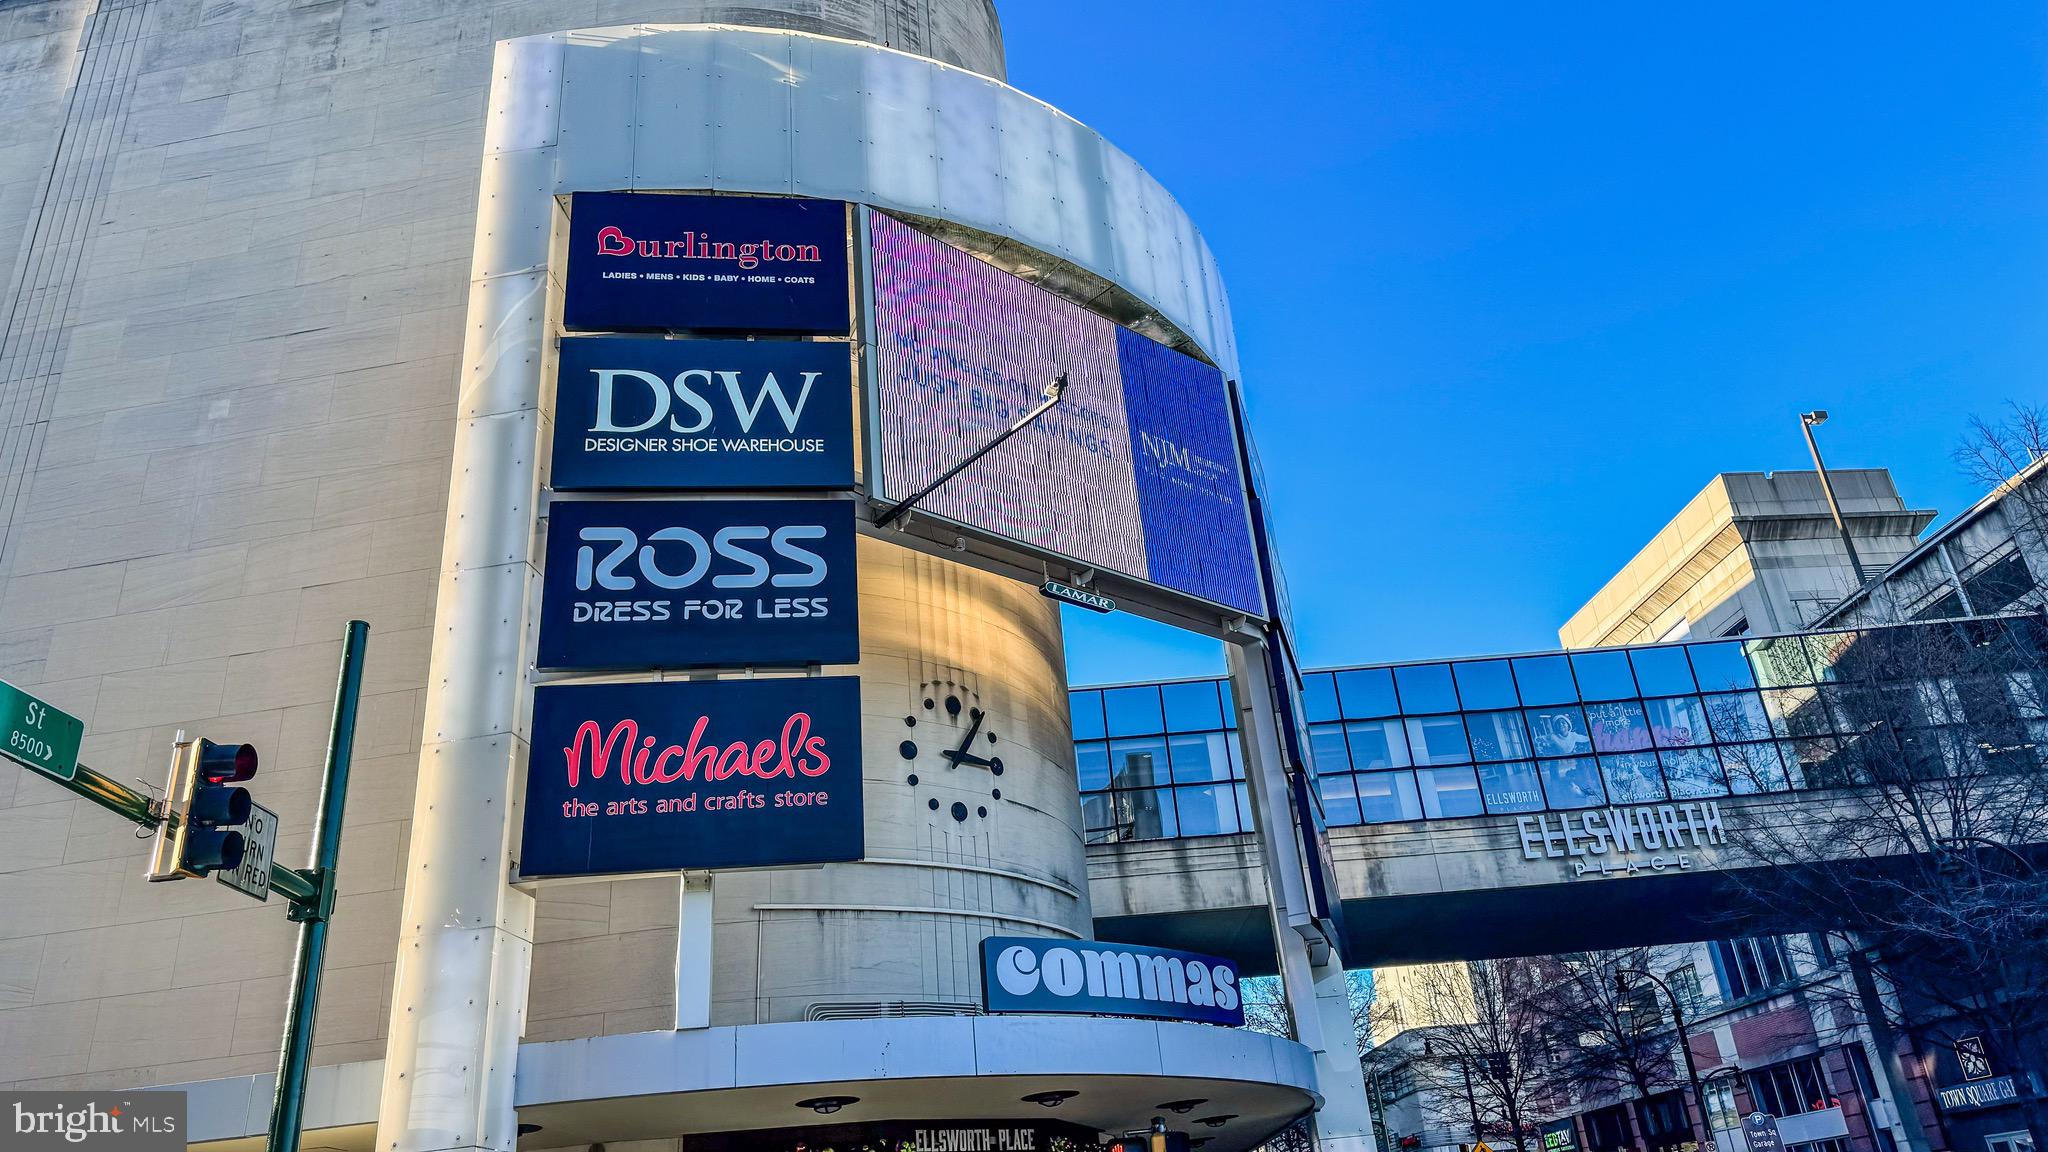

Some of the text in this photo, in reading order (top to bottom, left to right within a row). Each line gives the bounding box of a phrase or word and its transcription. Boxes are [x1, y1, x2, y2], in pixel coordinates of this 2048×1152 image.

[597, 225, 822, 269] Burlington
[602, 271, 815, 284] LADIES MENS KIDS BABY HOME COATS
[587, 368, 823, 435] DSW
[584, 438, 825, 453] DESIGNER SHOE WAREHOUSE
[575, 525, 828, 591] ROSS
[1052, 584, 1109, 609] LAMAR
[573, 597, 829, 623] DRESS FOR LESS
[25, 701, 47, 730] St
[10, 729, 44, 758] 8500
[563, 712, 831, 788] Michaels
[562, 789, 829, 818] the arts and crafts store
[1486, 790, 1540, 805] ELLSWORTH
[245, 813, 263, 835] NO
[1516, 801, 1728, 860] ELLSWORTH
[243, 863, 267, 888] RED
[1574, 853, 1691, 878] PLACE
[996, 945, 1239, 1011] commas
[1940, 1087, 1967, 1109] TOWN
[1965, 1082, 2000, 1107] SQUARE
[914, 1128, 1036, 1152] ELLSWORTH PLACE
[1750, 1128, 1777, 1138] Town Sq
[1753, 1140, 1775, 1148] Garage
